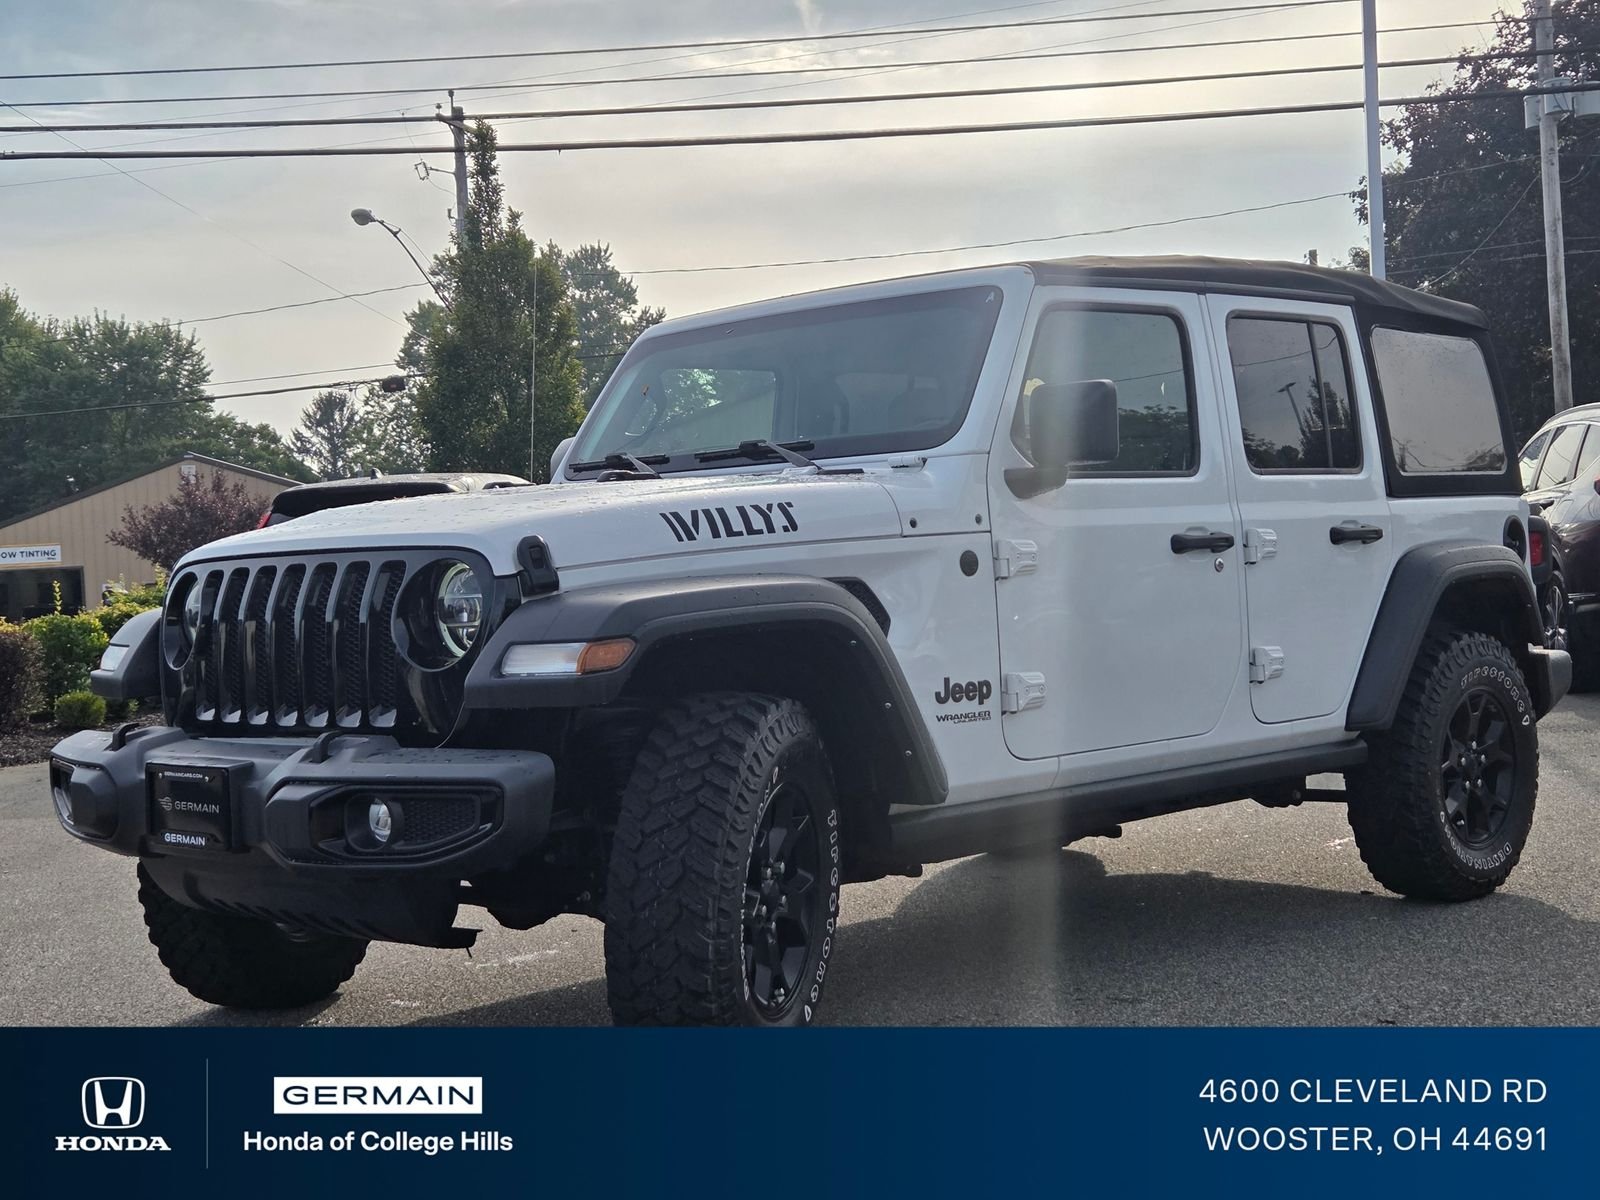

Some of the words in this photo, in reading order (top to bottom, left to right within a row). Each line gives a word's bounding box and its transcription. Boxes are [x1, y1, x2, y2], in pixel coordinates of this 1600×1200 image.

[659, 501, 798, 542] WILLYS
[19, 549, 57, 558] TINTING
[935, 677, 992, 705] Jeep
[936, 710, 991, 722] WRANGLER
[953, 716, 992, 724] UNLIMITED
[174, 801, 220, 813] GERMAIN
[164, 833, 206, 846] GERMAIN
